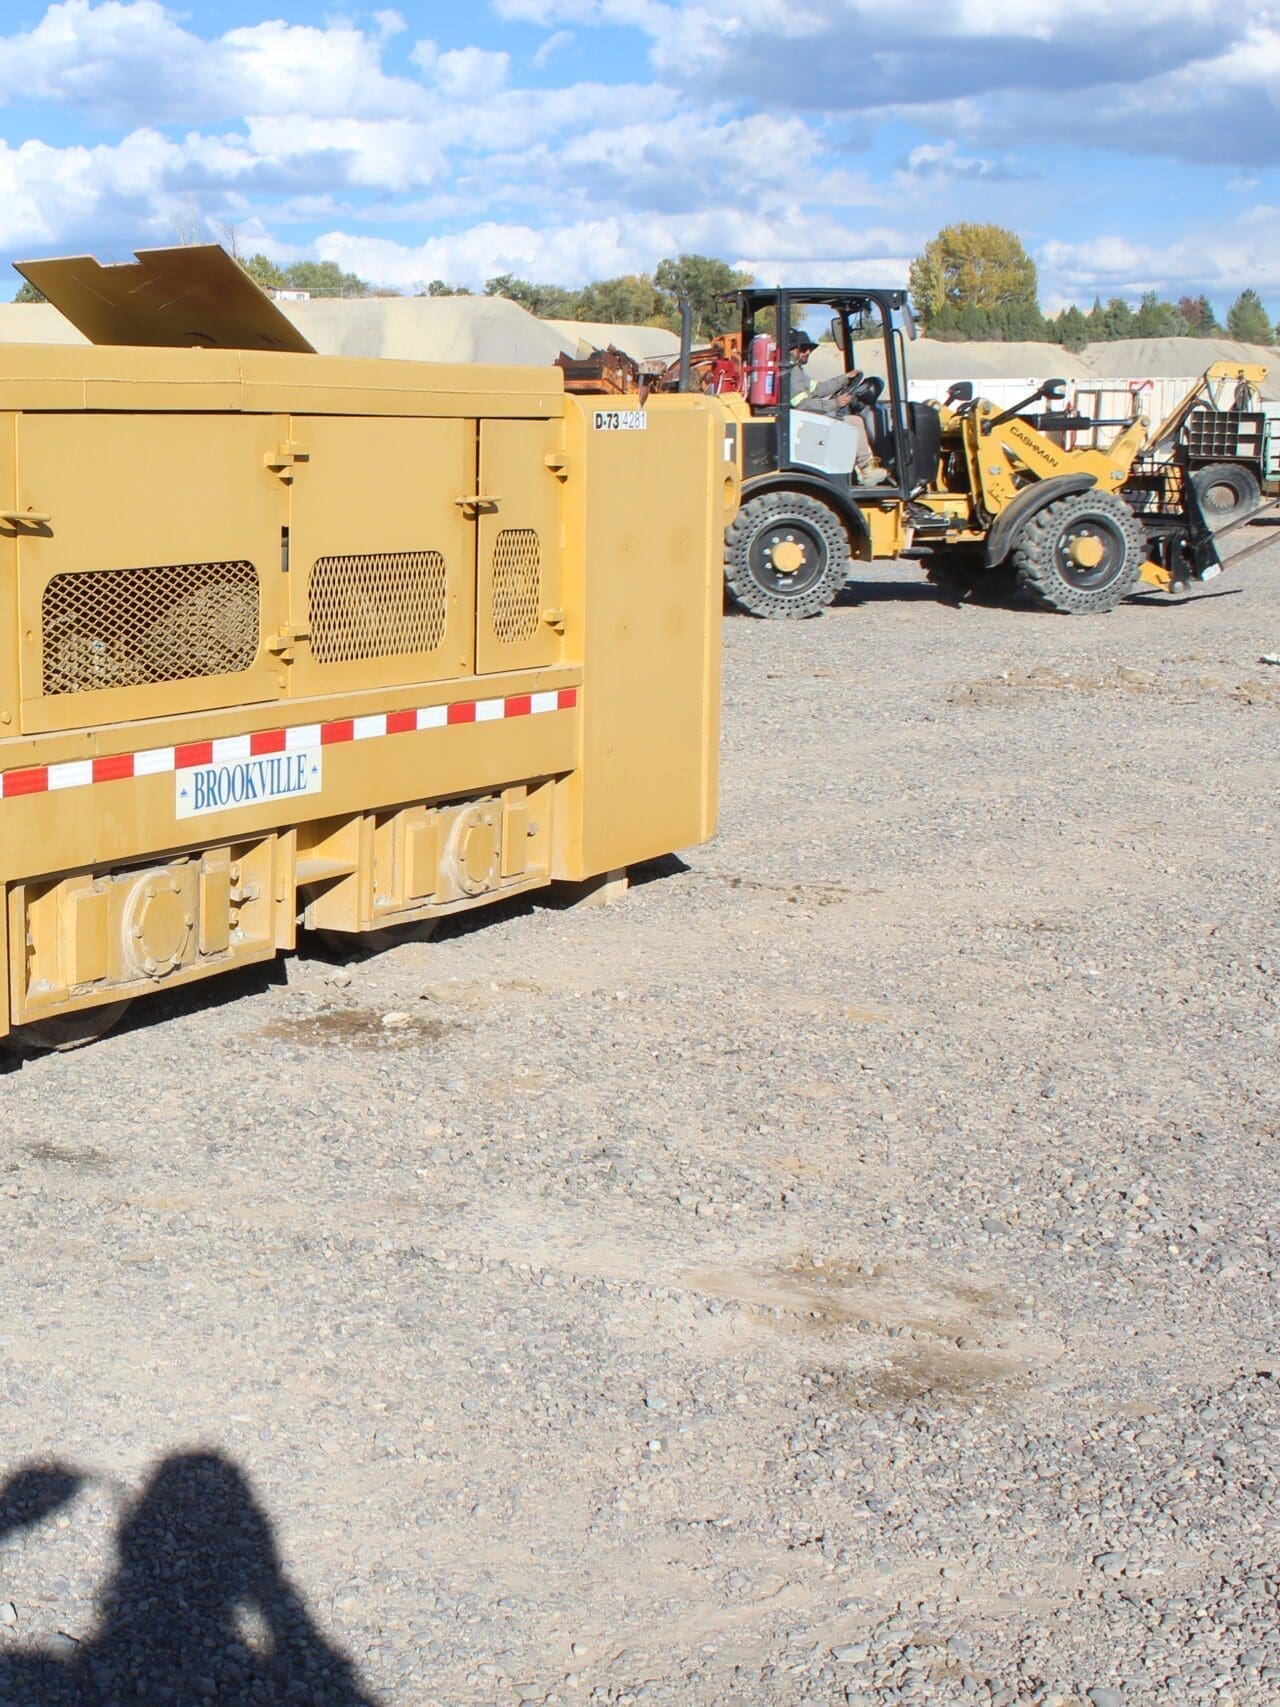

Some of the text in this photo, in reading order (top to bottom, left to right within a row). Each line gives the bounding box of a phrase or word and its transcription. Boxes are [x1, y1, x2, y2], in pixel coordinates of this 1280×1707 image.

[595, 413, 619, 429] D-73
[1010, 426, 1059, 468] CASHMAN
[193, 754, 307, 810] BROOKVILLE
